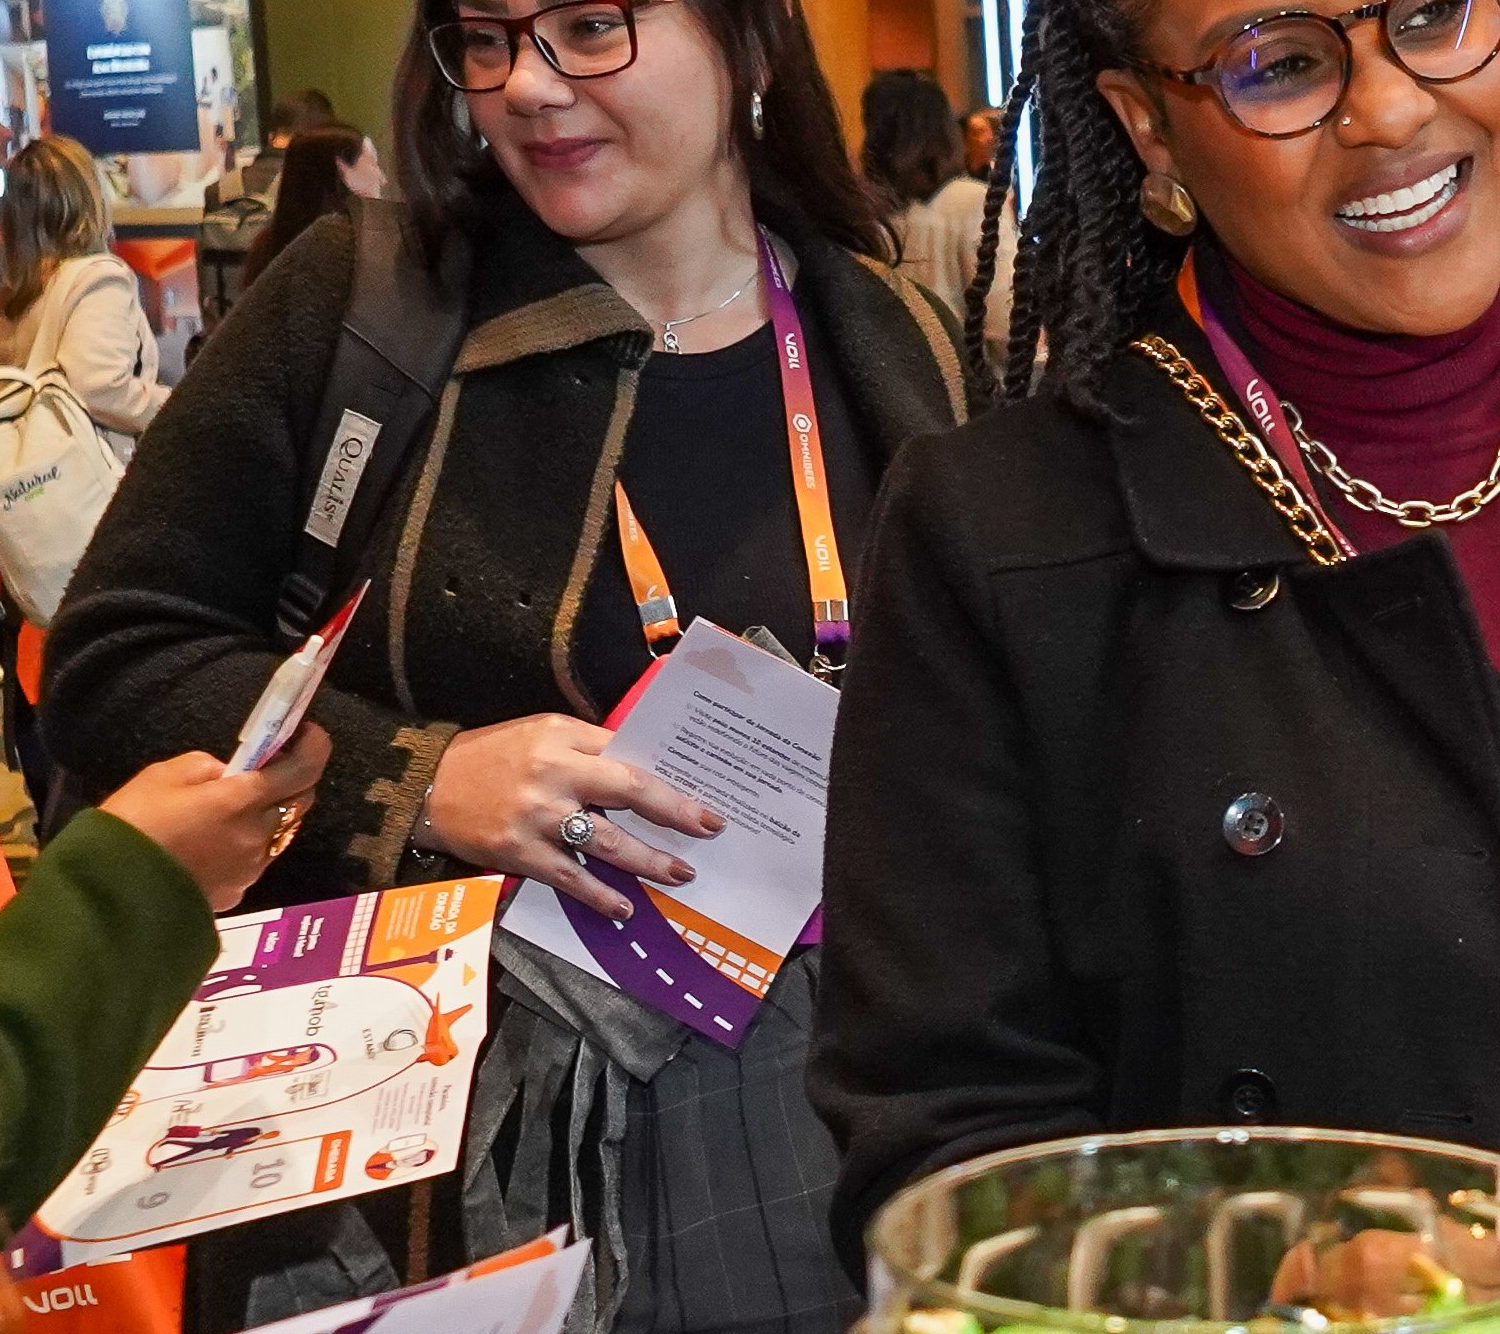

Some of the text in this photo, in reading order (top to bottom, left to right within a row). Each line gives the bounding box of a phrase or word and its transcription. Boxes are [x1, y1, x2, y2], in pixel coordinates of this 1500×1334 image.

[785, 333, 801, 369] VOLL
[1245, 378, 1276, 436] VOLL
[814, 535, 831, 573] VOLL
[22, 1283, 100, 1314] VOLL
